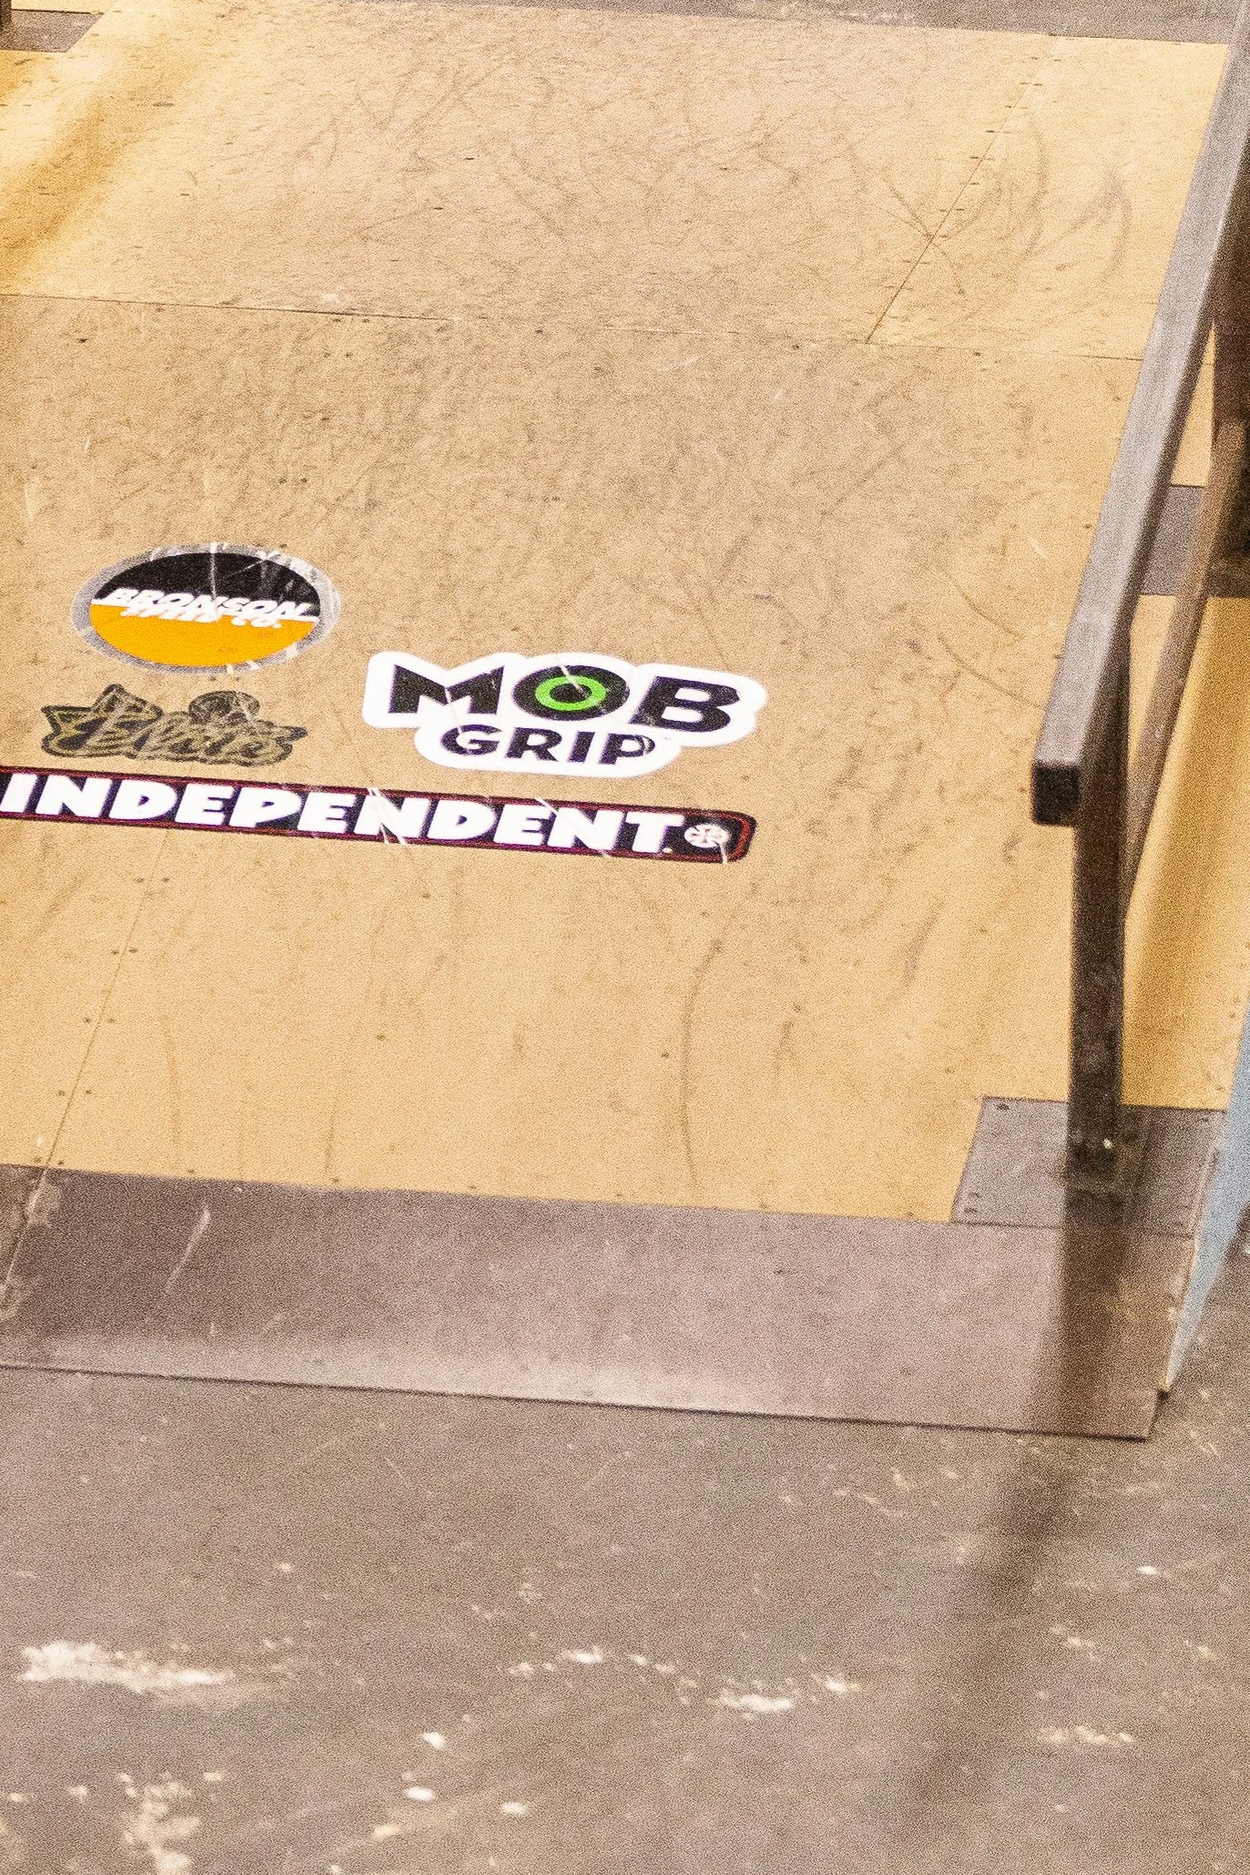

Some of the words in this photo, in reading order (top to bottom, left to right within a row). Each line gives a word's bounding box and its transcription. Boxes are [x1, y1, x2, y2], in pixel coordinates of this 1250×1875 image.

[99, 587, 313, 622] BRONSON
[387, 663, 741, 733] MOB
[440, 723, 657, 766] GRIP
